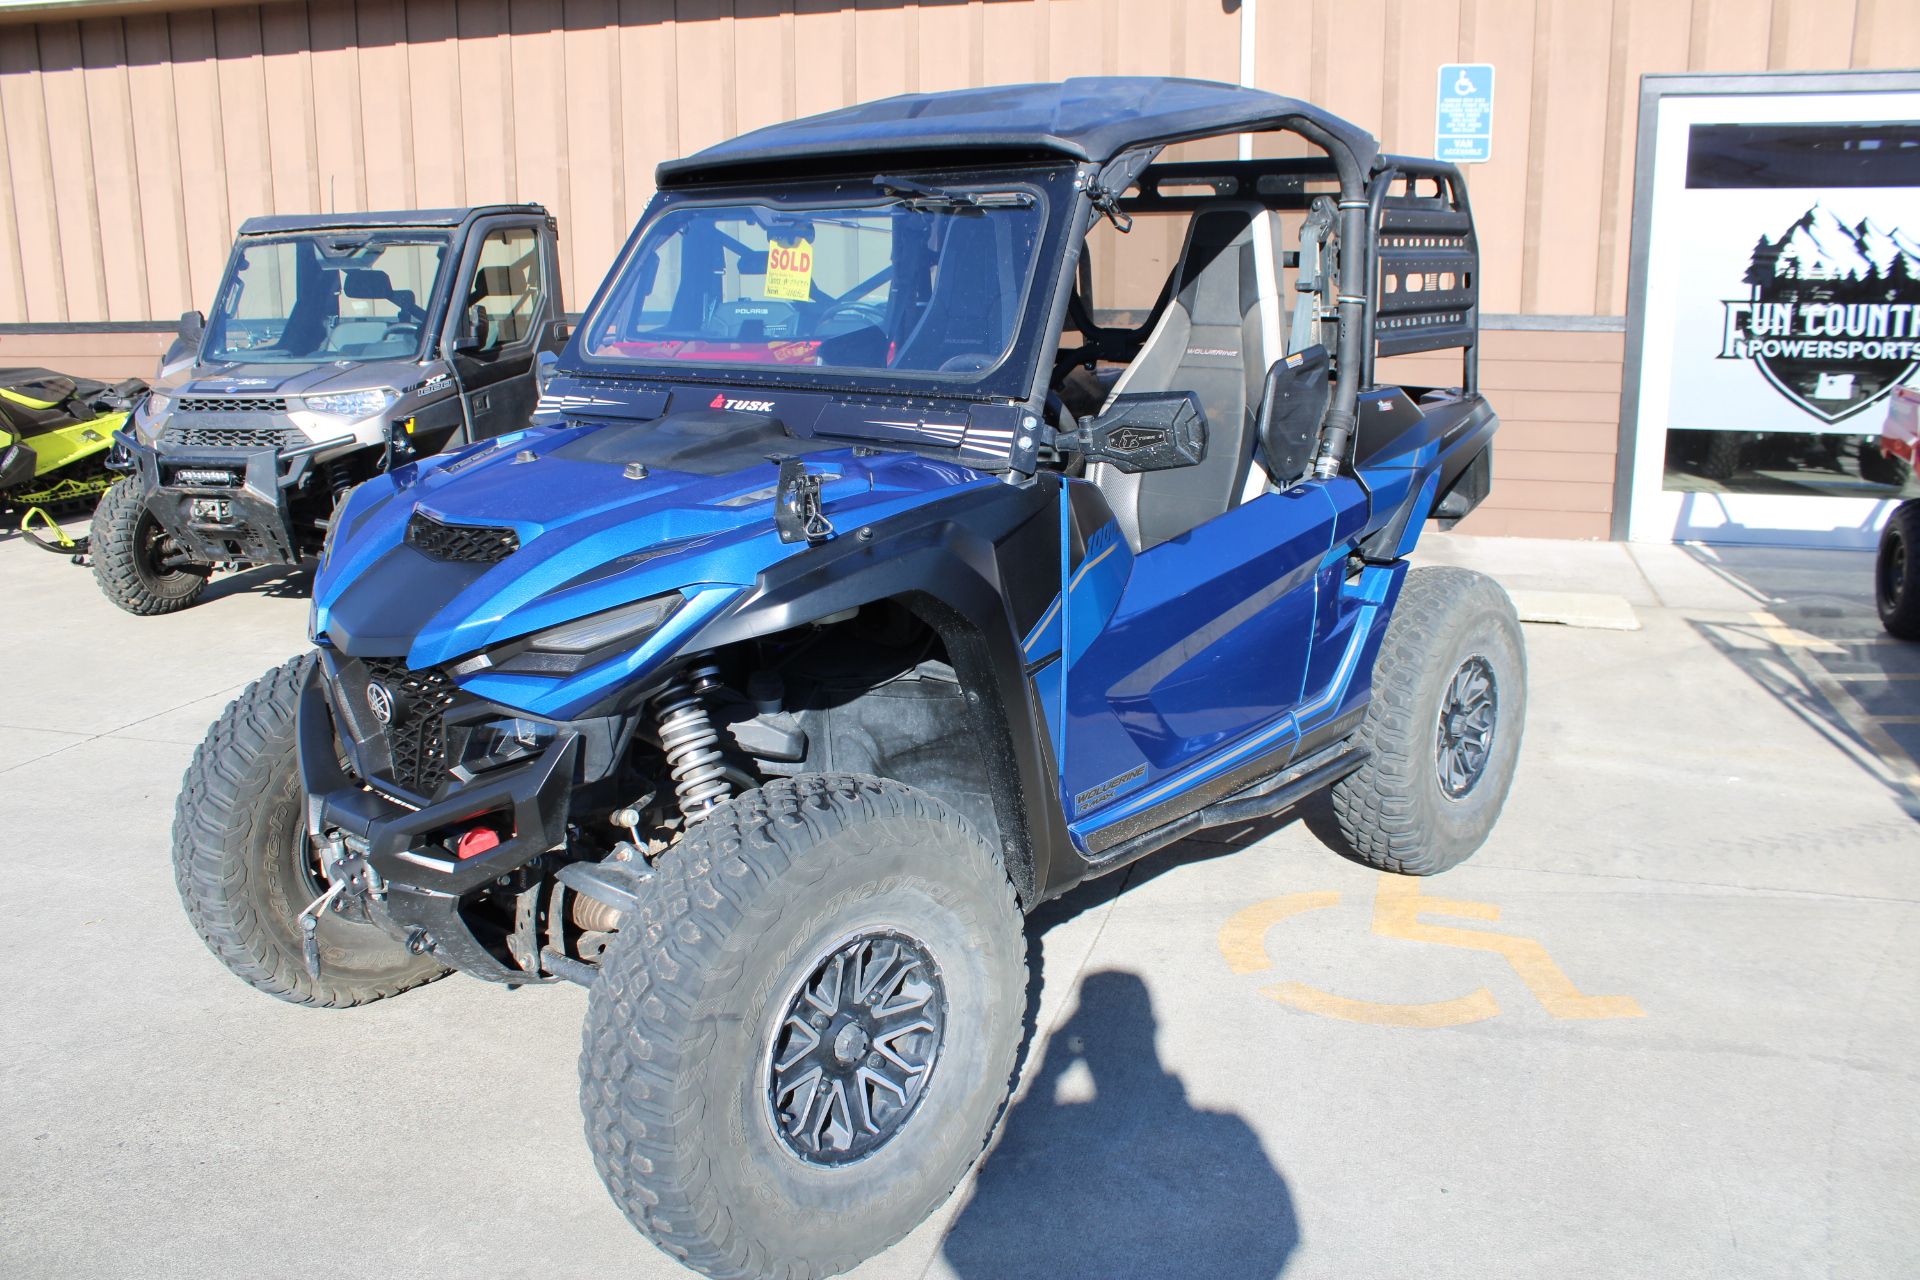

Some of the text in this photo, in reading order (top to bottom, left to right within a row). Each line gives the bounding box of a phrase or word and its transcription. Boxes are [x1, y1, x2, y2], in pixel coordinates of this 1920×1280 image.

[770, 248, 811, 273] SOLD
[1717, 301, 1794, 358] FUN
[1748, 340, 1920, 360] POWERSPORTS
[417, 379, 452, 397] 1000
[425, 373, 447, 387] XP
[723, 399, 776, 412] TUSK
[1077, 766, 1145, 804] WOLVERINE
